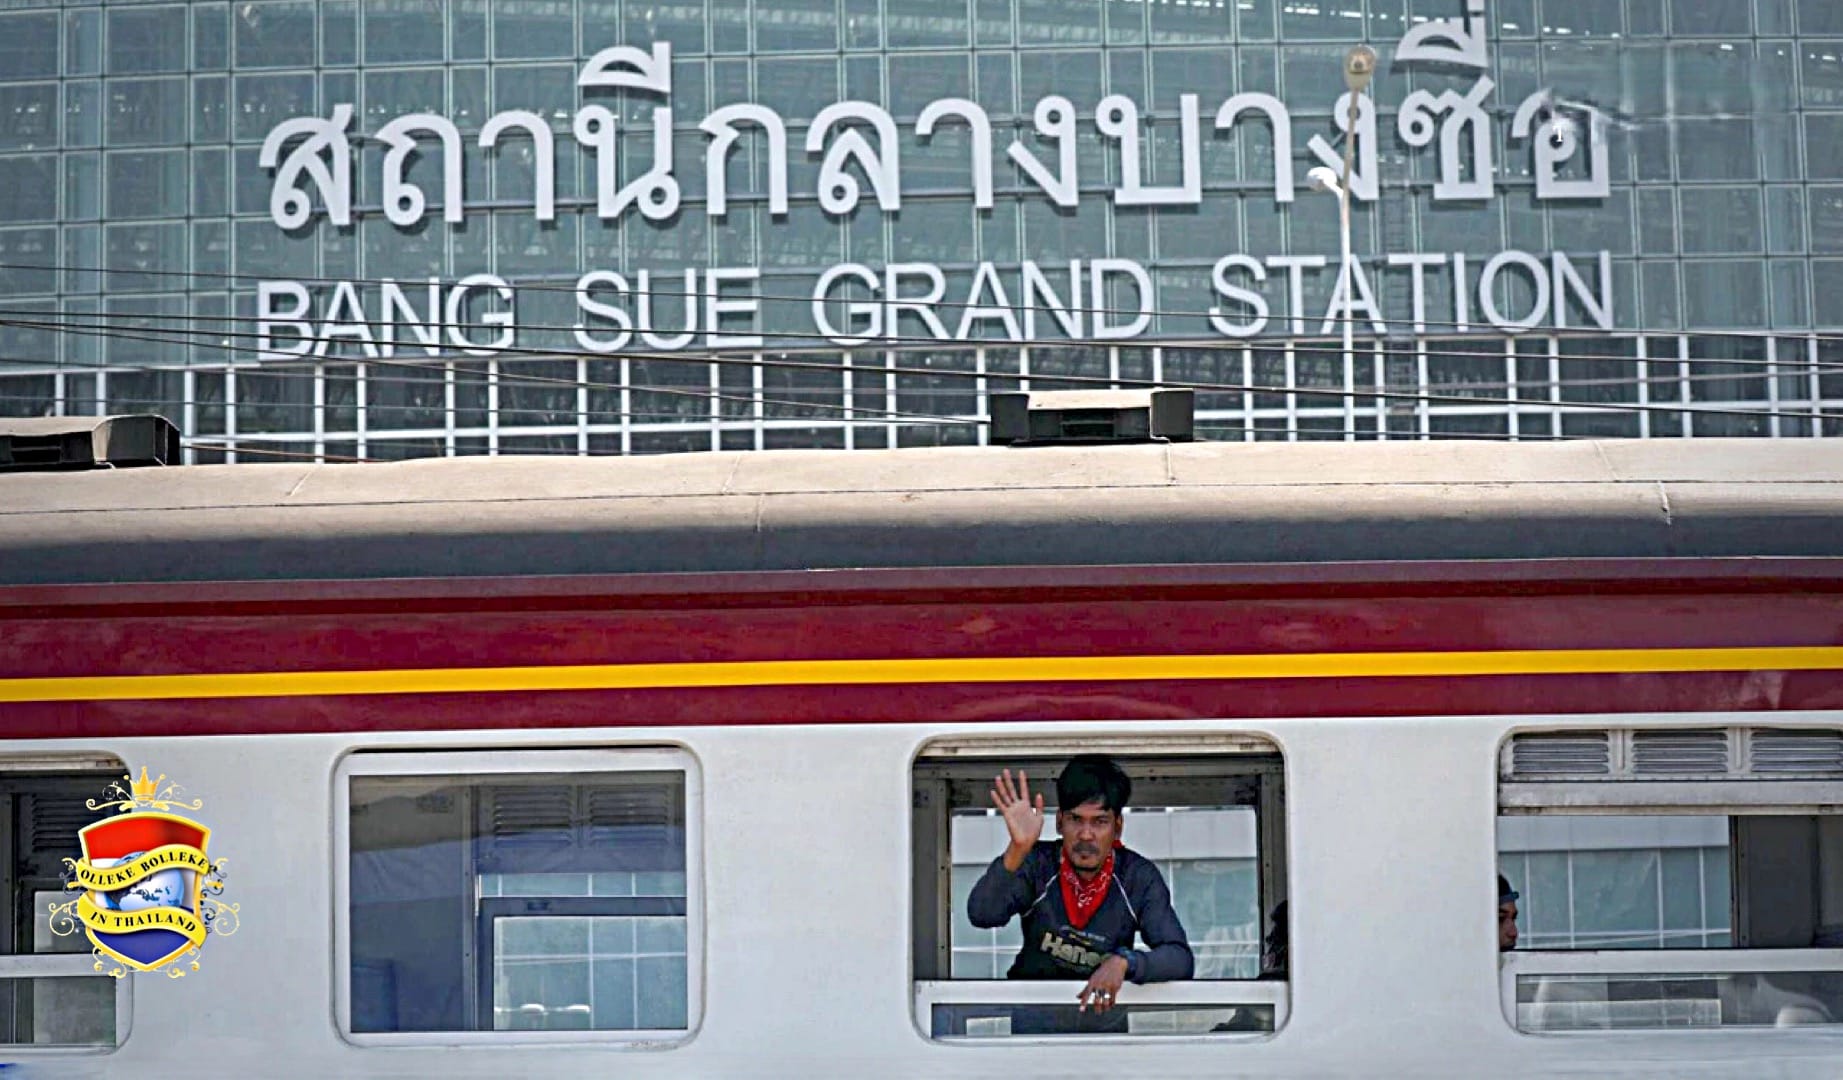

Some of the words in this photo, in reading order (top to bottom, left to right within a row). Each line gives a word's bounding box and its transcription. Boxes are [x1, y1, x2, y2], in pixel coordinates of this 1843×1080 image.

[257, 273, 518, 363] BANG
[573, 267, 764, 352] SUE
[811, 261, 1156, 347] GRAND
[1210, 251, 1615, 338] STATION
